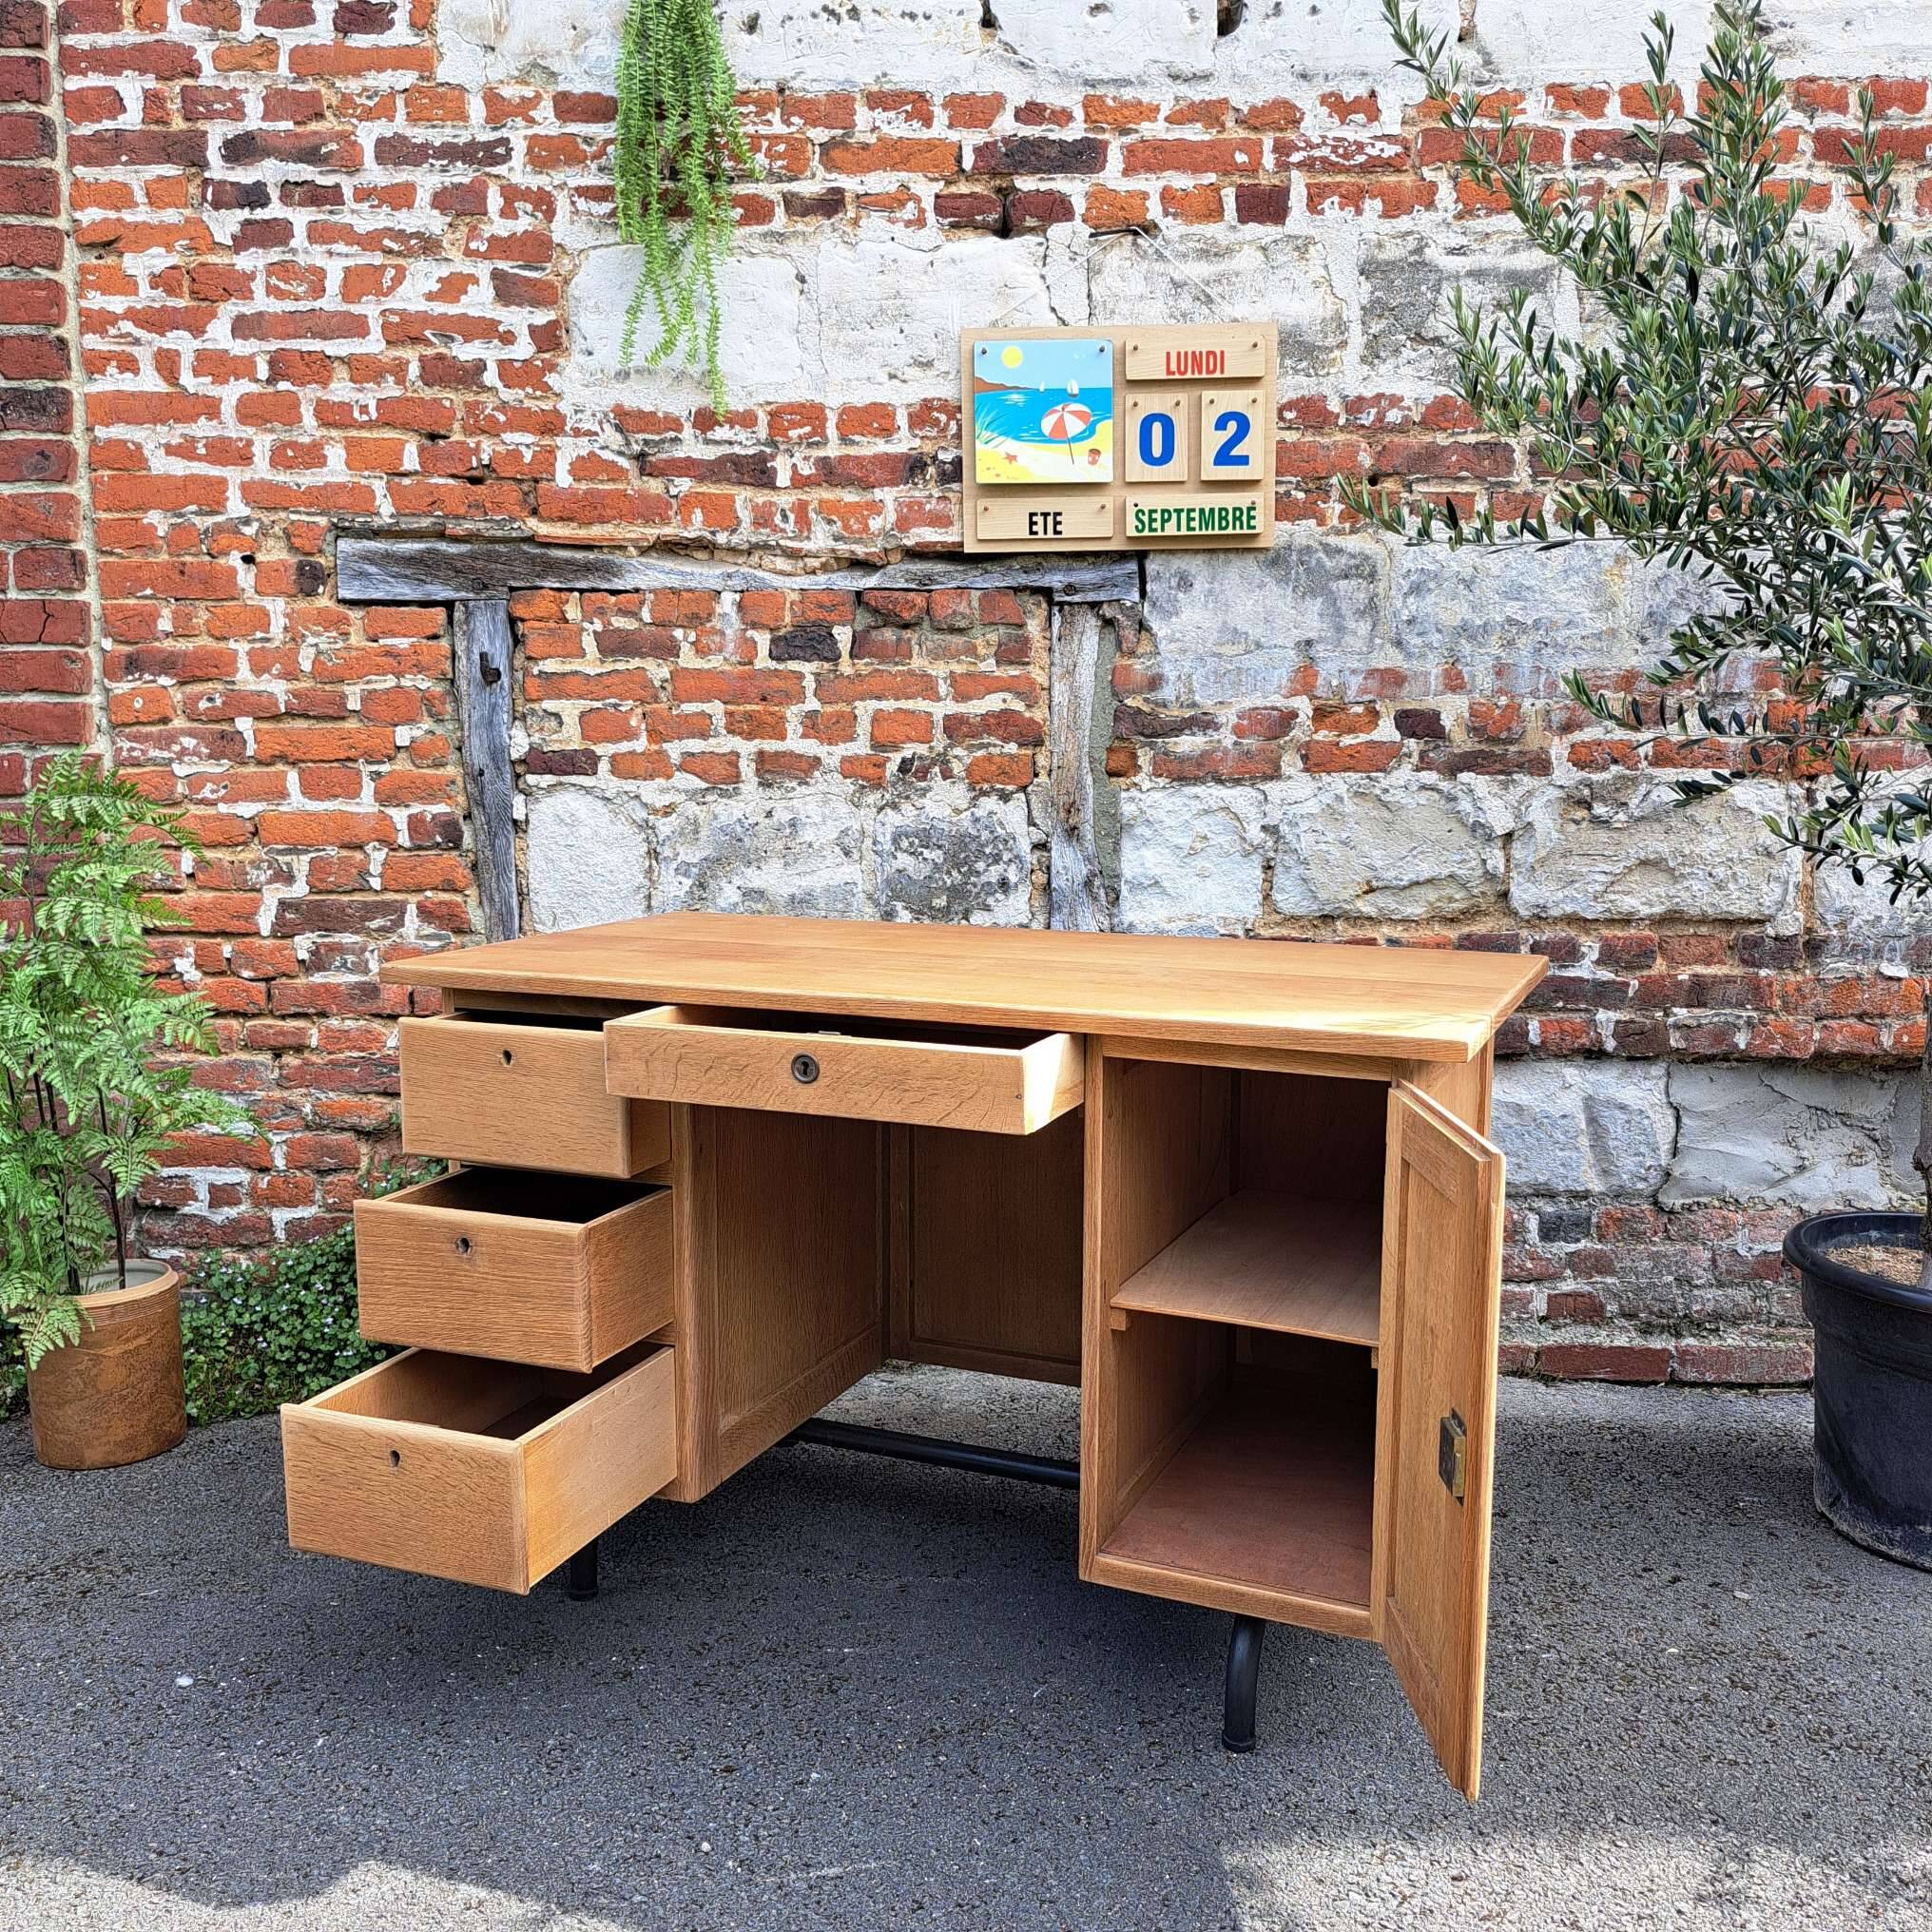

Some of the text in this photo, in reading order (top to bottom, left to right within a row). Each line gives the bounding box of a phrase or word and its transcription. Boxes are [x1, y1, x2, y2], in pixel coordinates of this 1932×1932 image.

[1165, 350, 1226, 377] LUNDI
[1028, 512, 1063, 535] ETE
[1134, 506, 1257, 533] SEPTEMBRE
